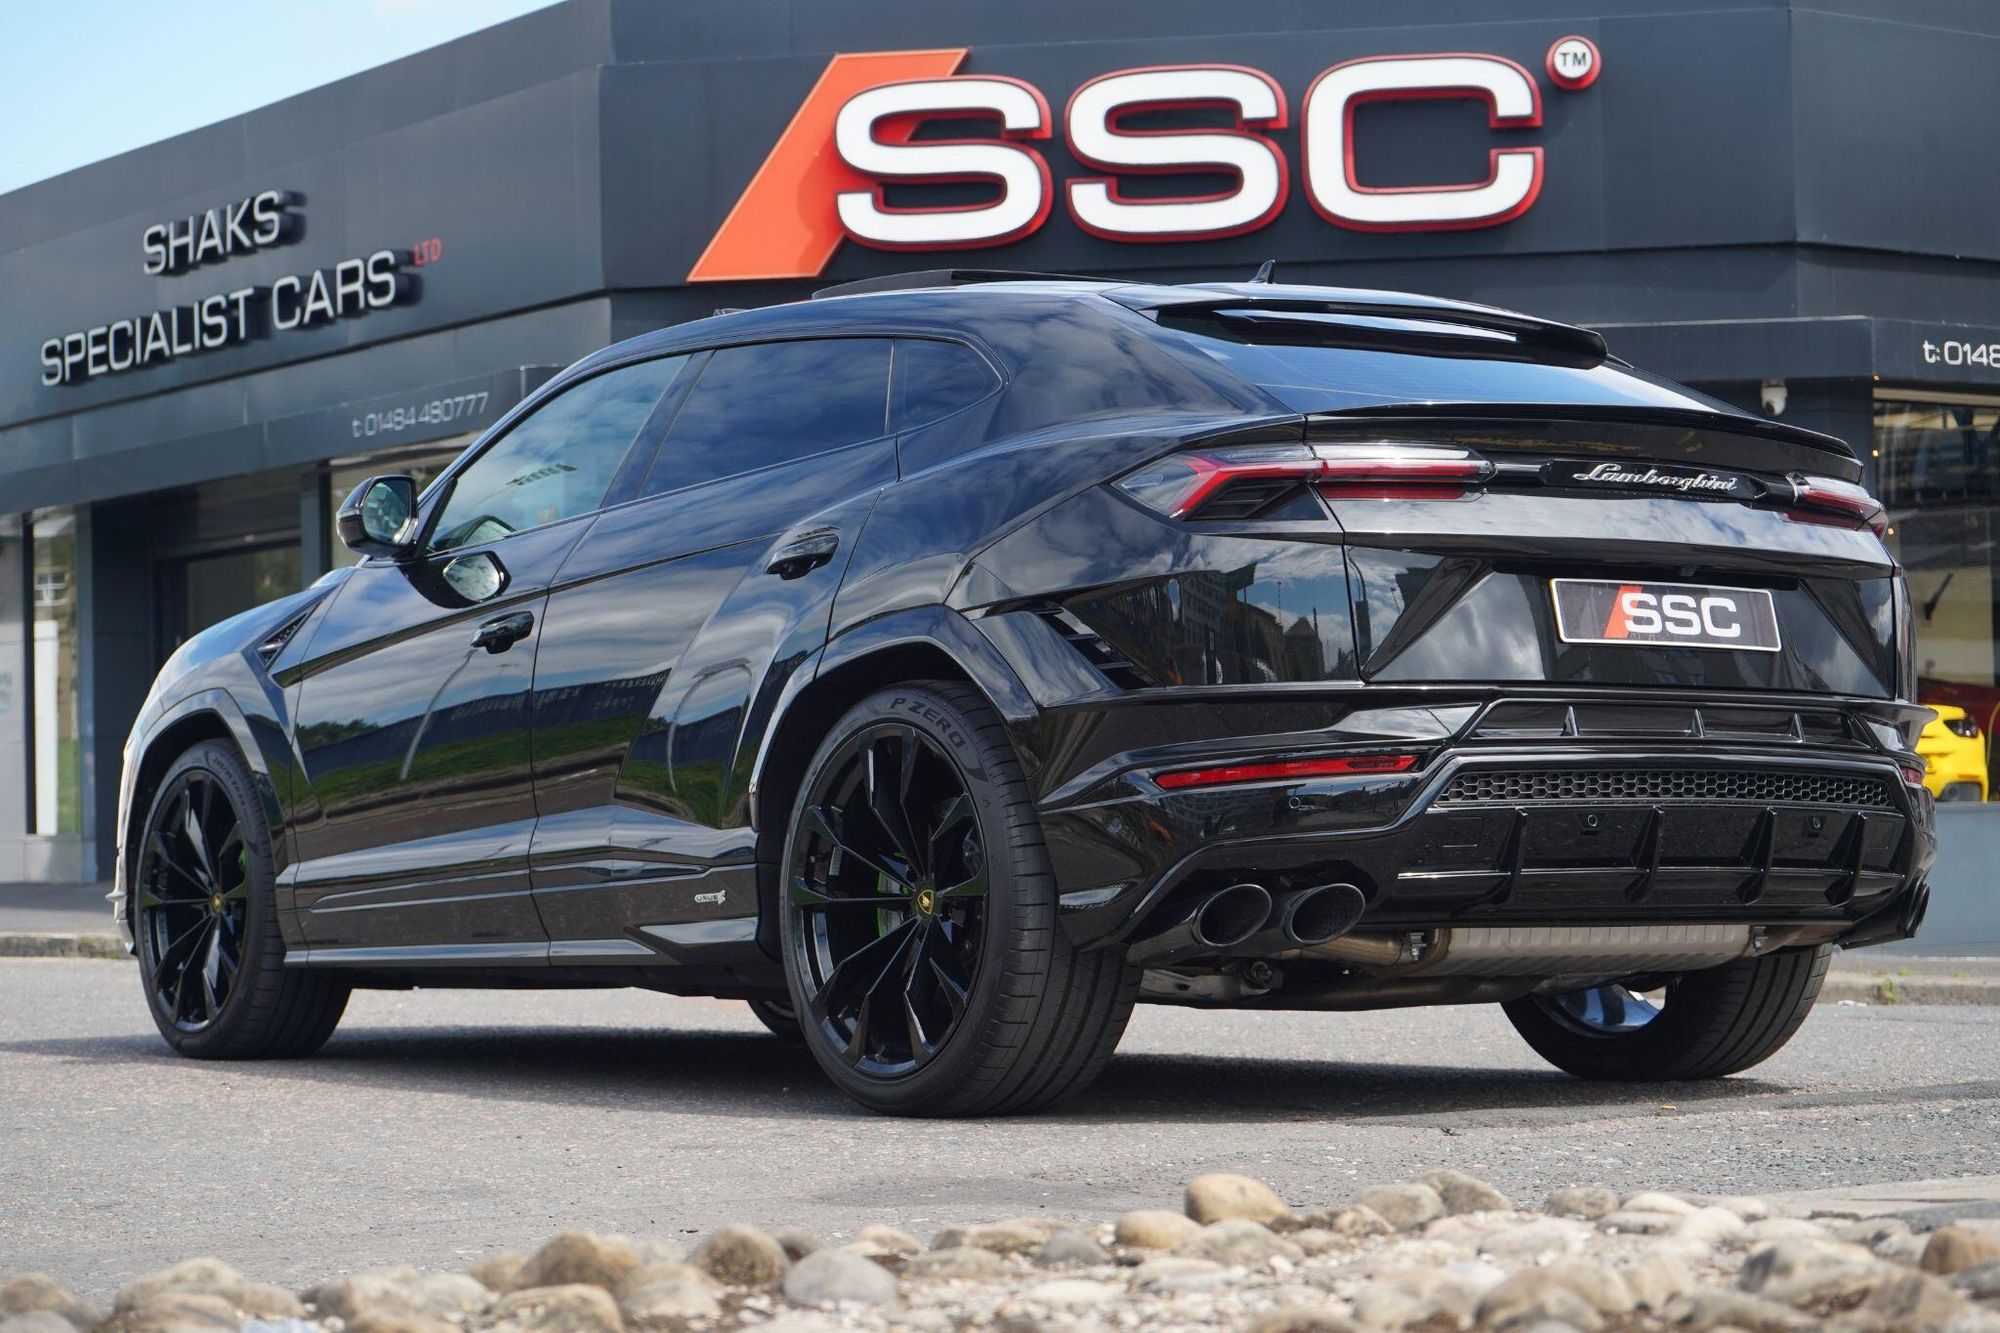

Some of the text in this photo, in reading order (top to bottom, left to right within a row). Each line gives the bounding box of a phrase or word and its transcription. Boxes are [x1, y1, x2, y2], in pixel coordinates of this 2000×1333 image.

[833, 52, 1587, 251] SSC TM
[143, 190, 282, 276] SHAKS
[40, 238, 442, 387] SPECIALIST CARS LTD
[1572, 463, 1738, 491] Lamborghini
[1621, 592, 1741, 638] SSC
[907, 701, 967, 748] ZERO
